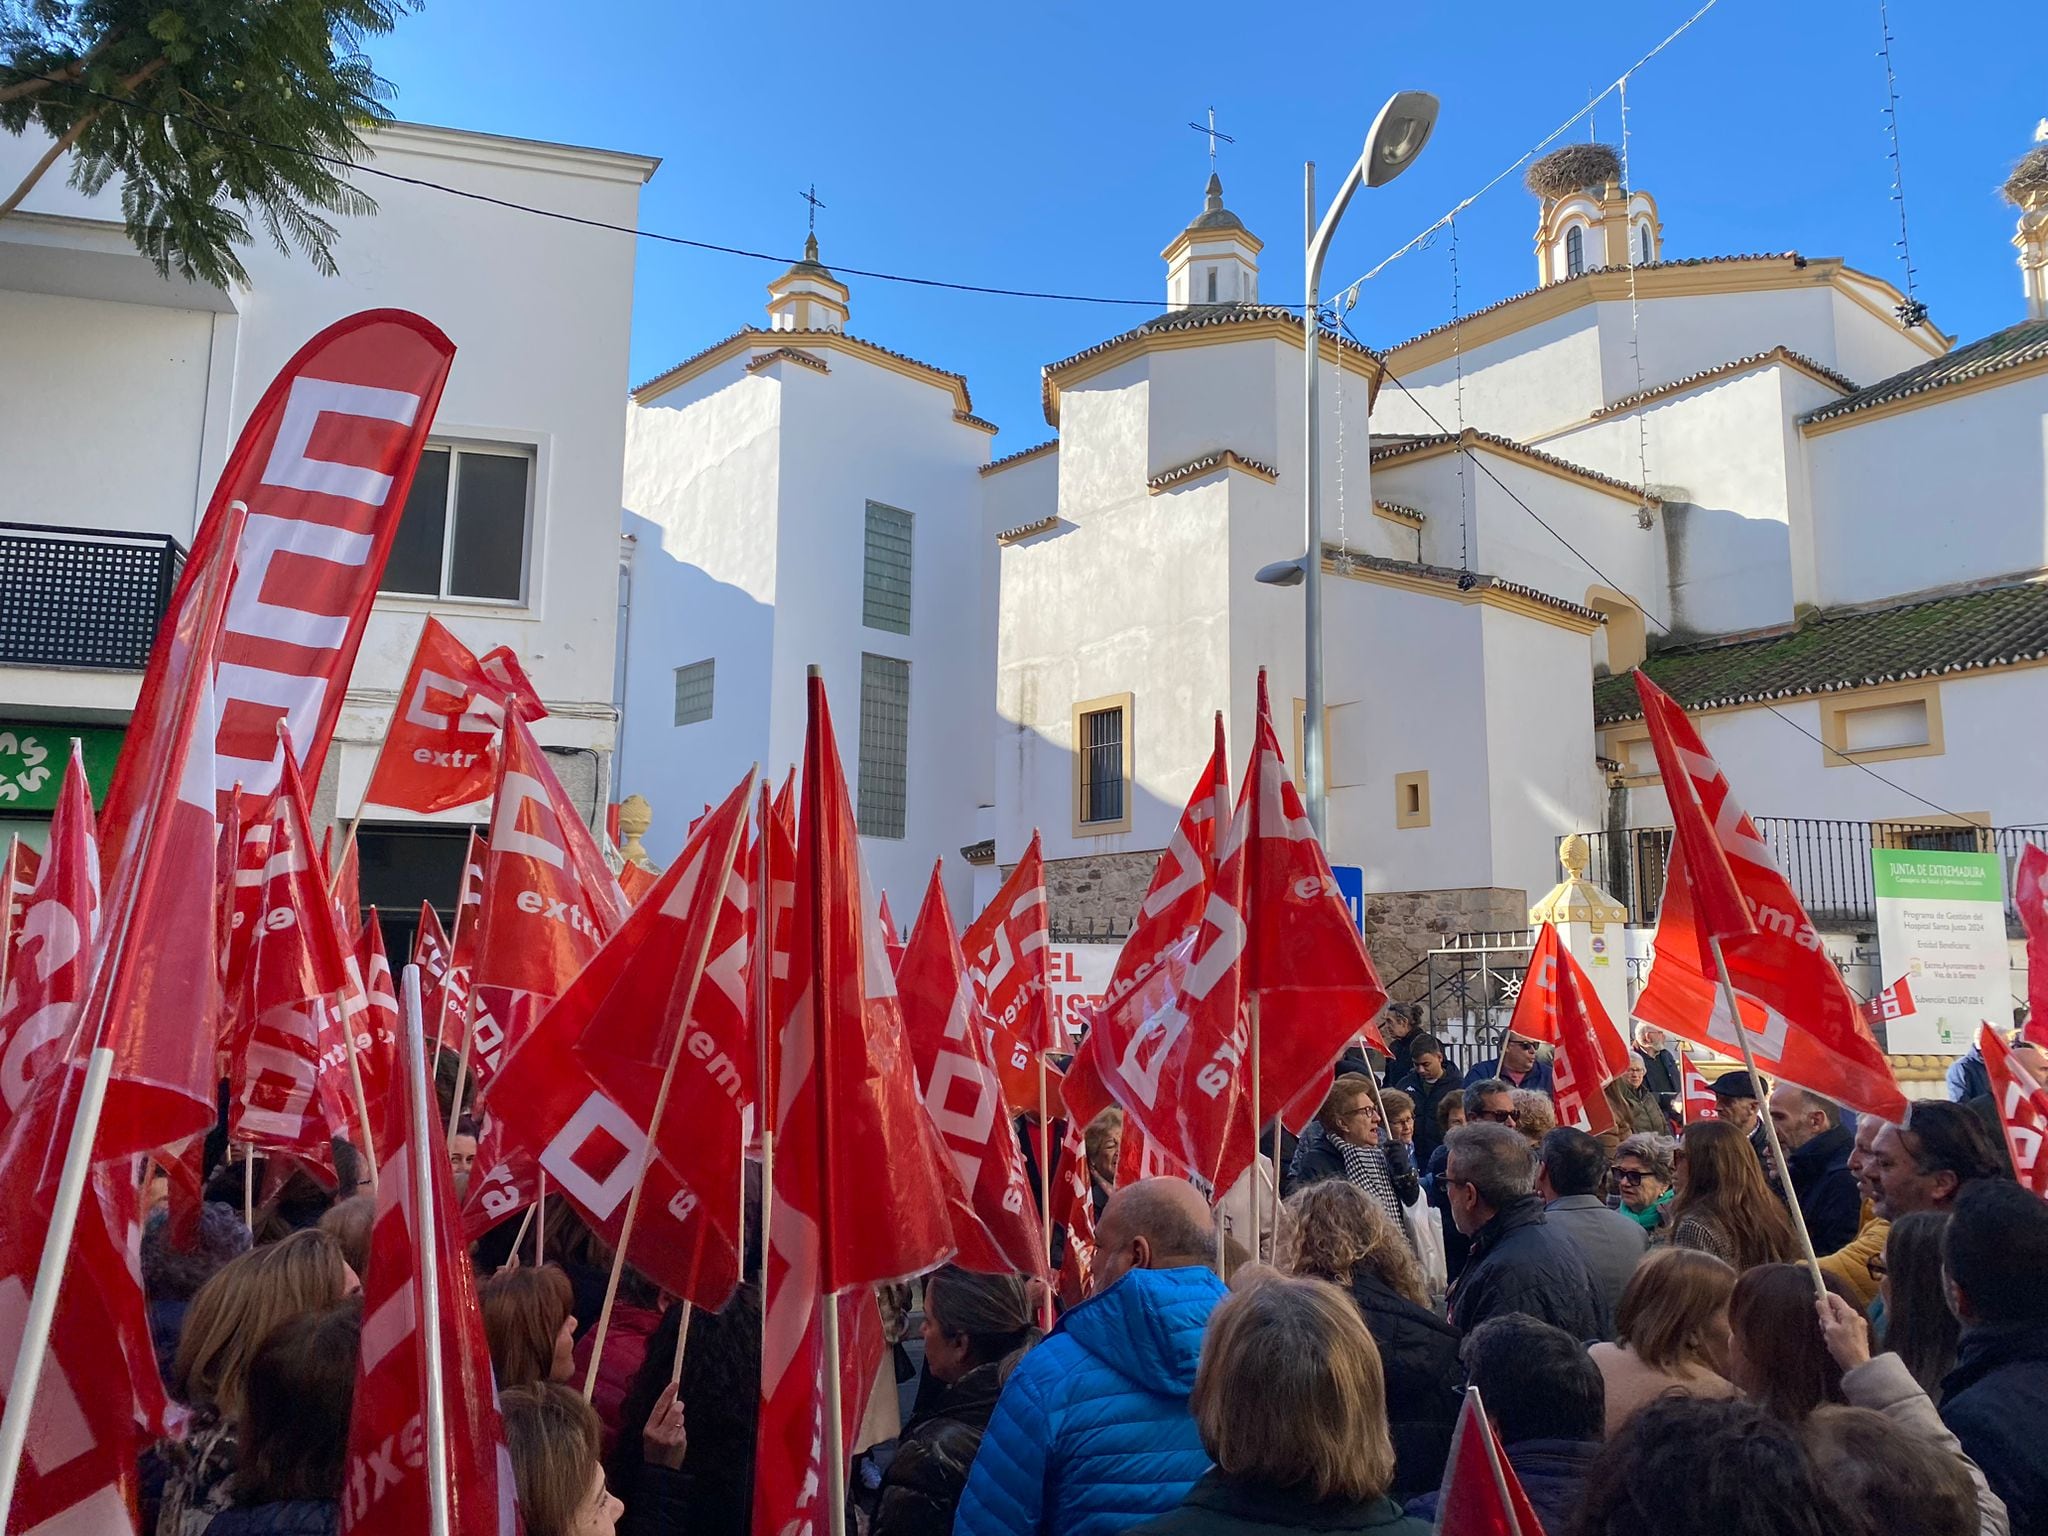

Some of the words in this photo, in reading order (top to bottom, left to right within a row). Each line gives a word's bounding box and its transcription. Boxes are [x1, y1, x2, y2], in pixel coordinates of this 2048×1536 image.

[1889, 862, 1915, 876] JUNTA
[1917, 864, 1927, 876] DE
[1929, 864, 1986, 878] EXTREMADURA
[1903, 910, 1935, 921] Programa
[1936, 911, 1944, 919] de
[1973, 913, 1984, 921] del
[1904, 921, 1931, 932] Hospital
[1932, 922, 1950, 931] Santa
[1968, 924, 1985, 932] 2024
